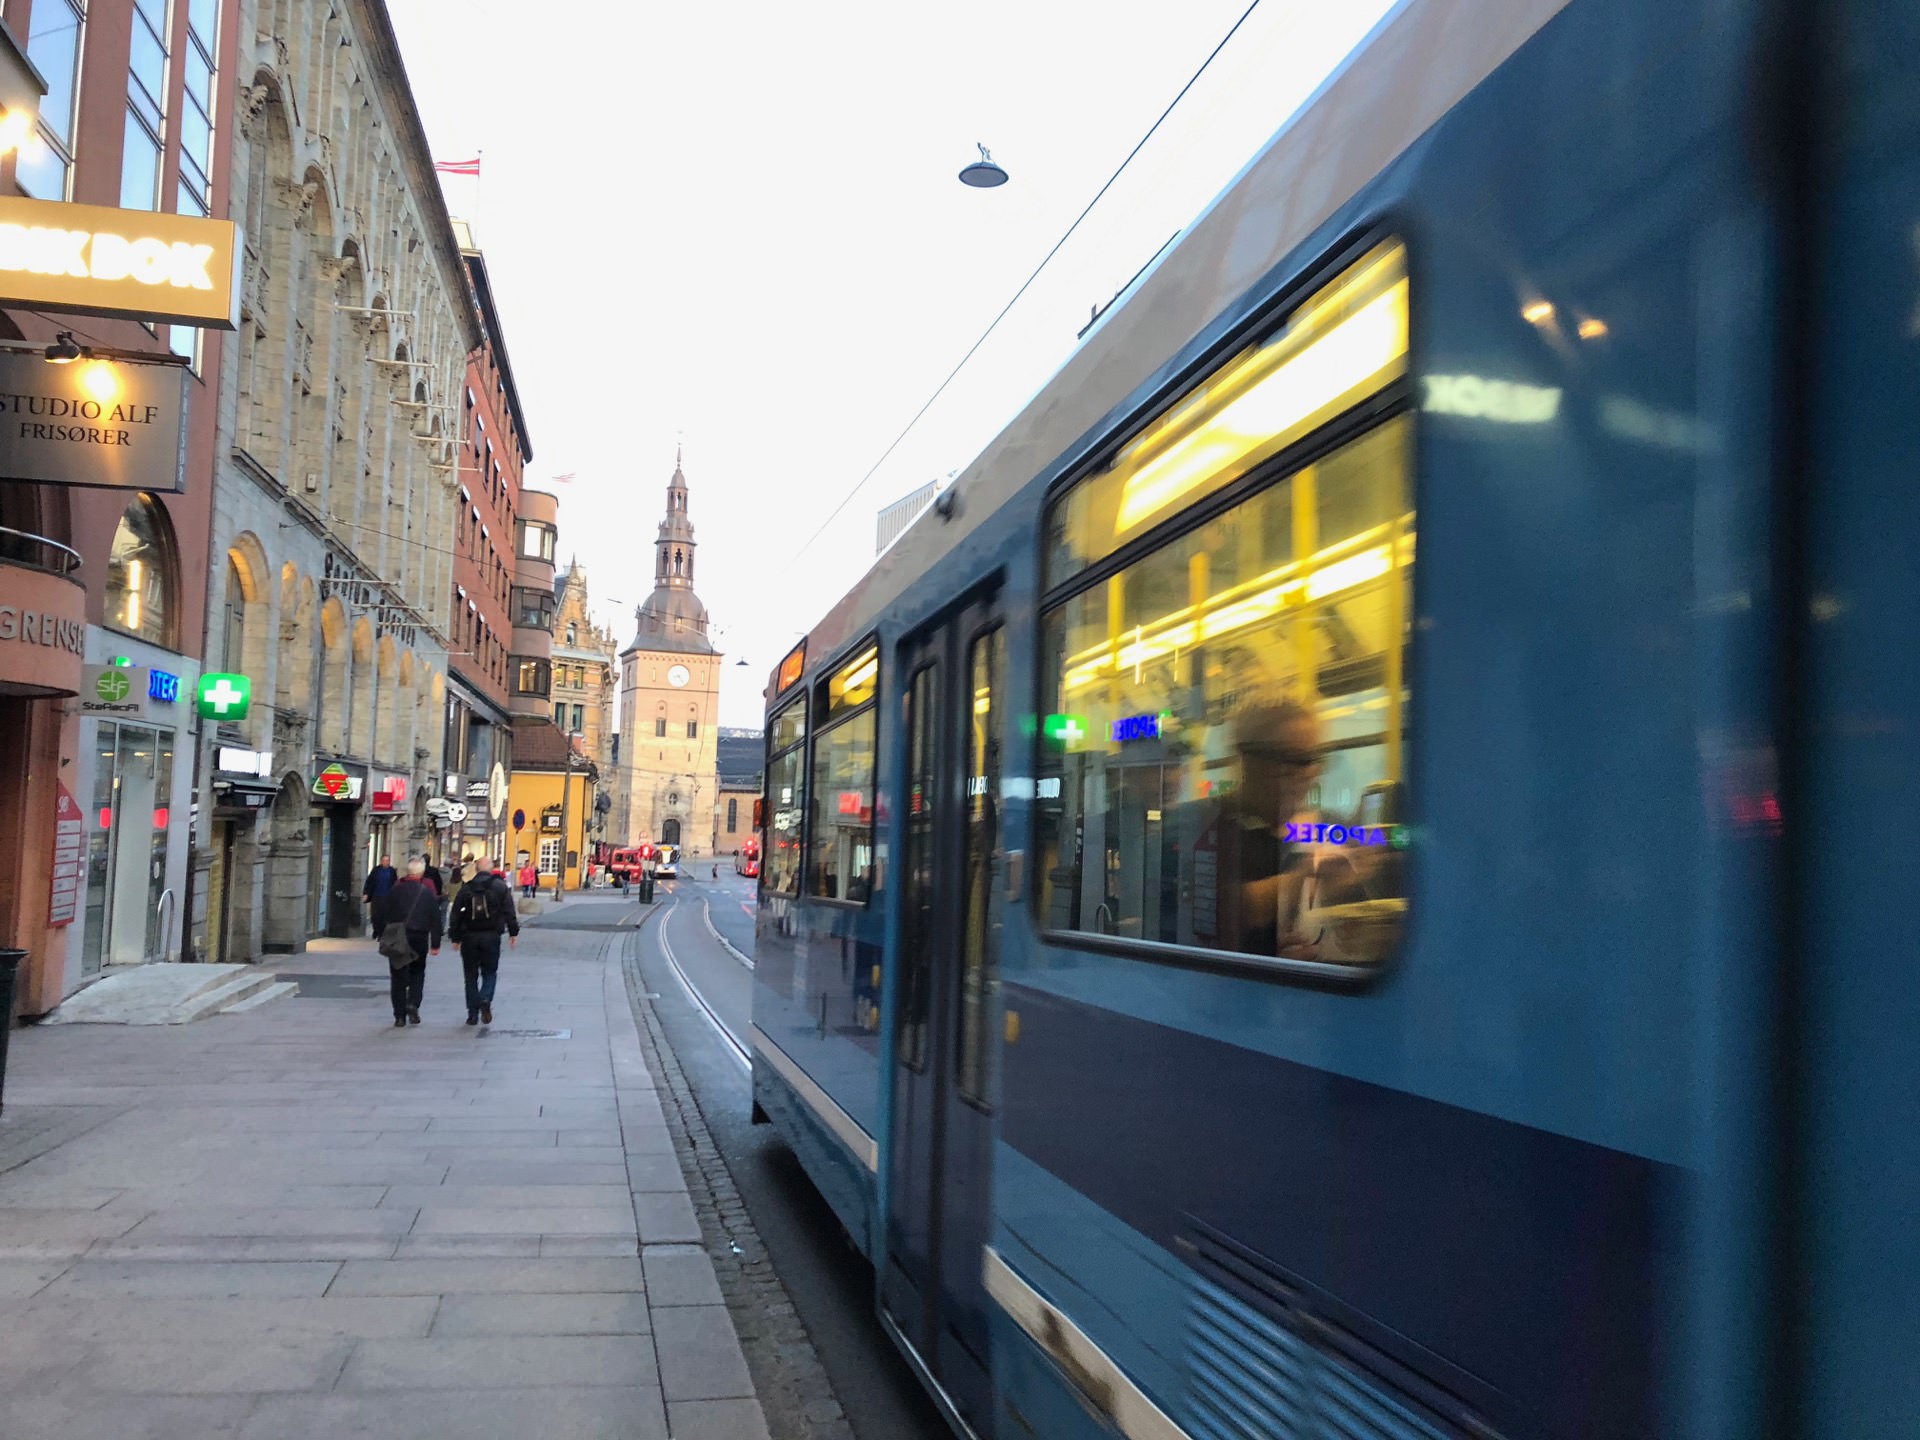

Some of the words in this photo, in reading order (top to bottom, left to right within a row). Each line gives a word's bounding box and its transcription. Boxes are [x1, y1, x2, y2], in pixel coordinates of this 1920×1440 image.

[0, 393, 101, 420] STUDIO
[109, 403, 159, 425] ALF
[19, 422, 131, 447] FRISØRER
